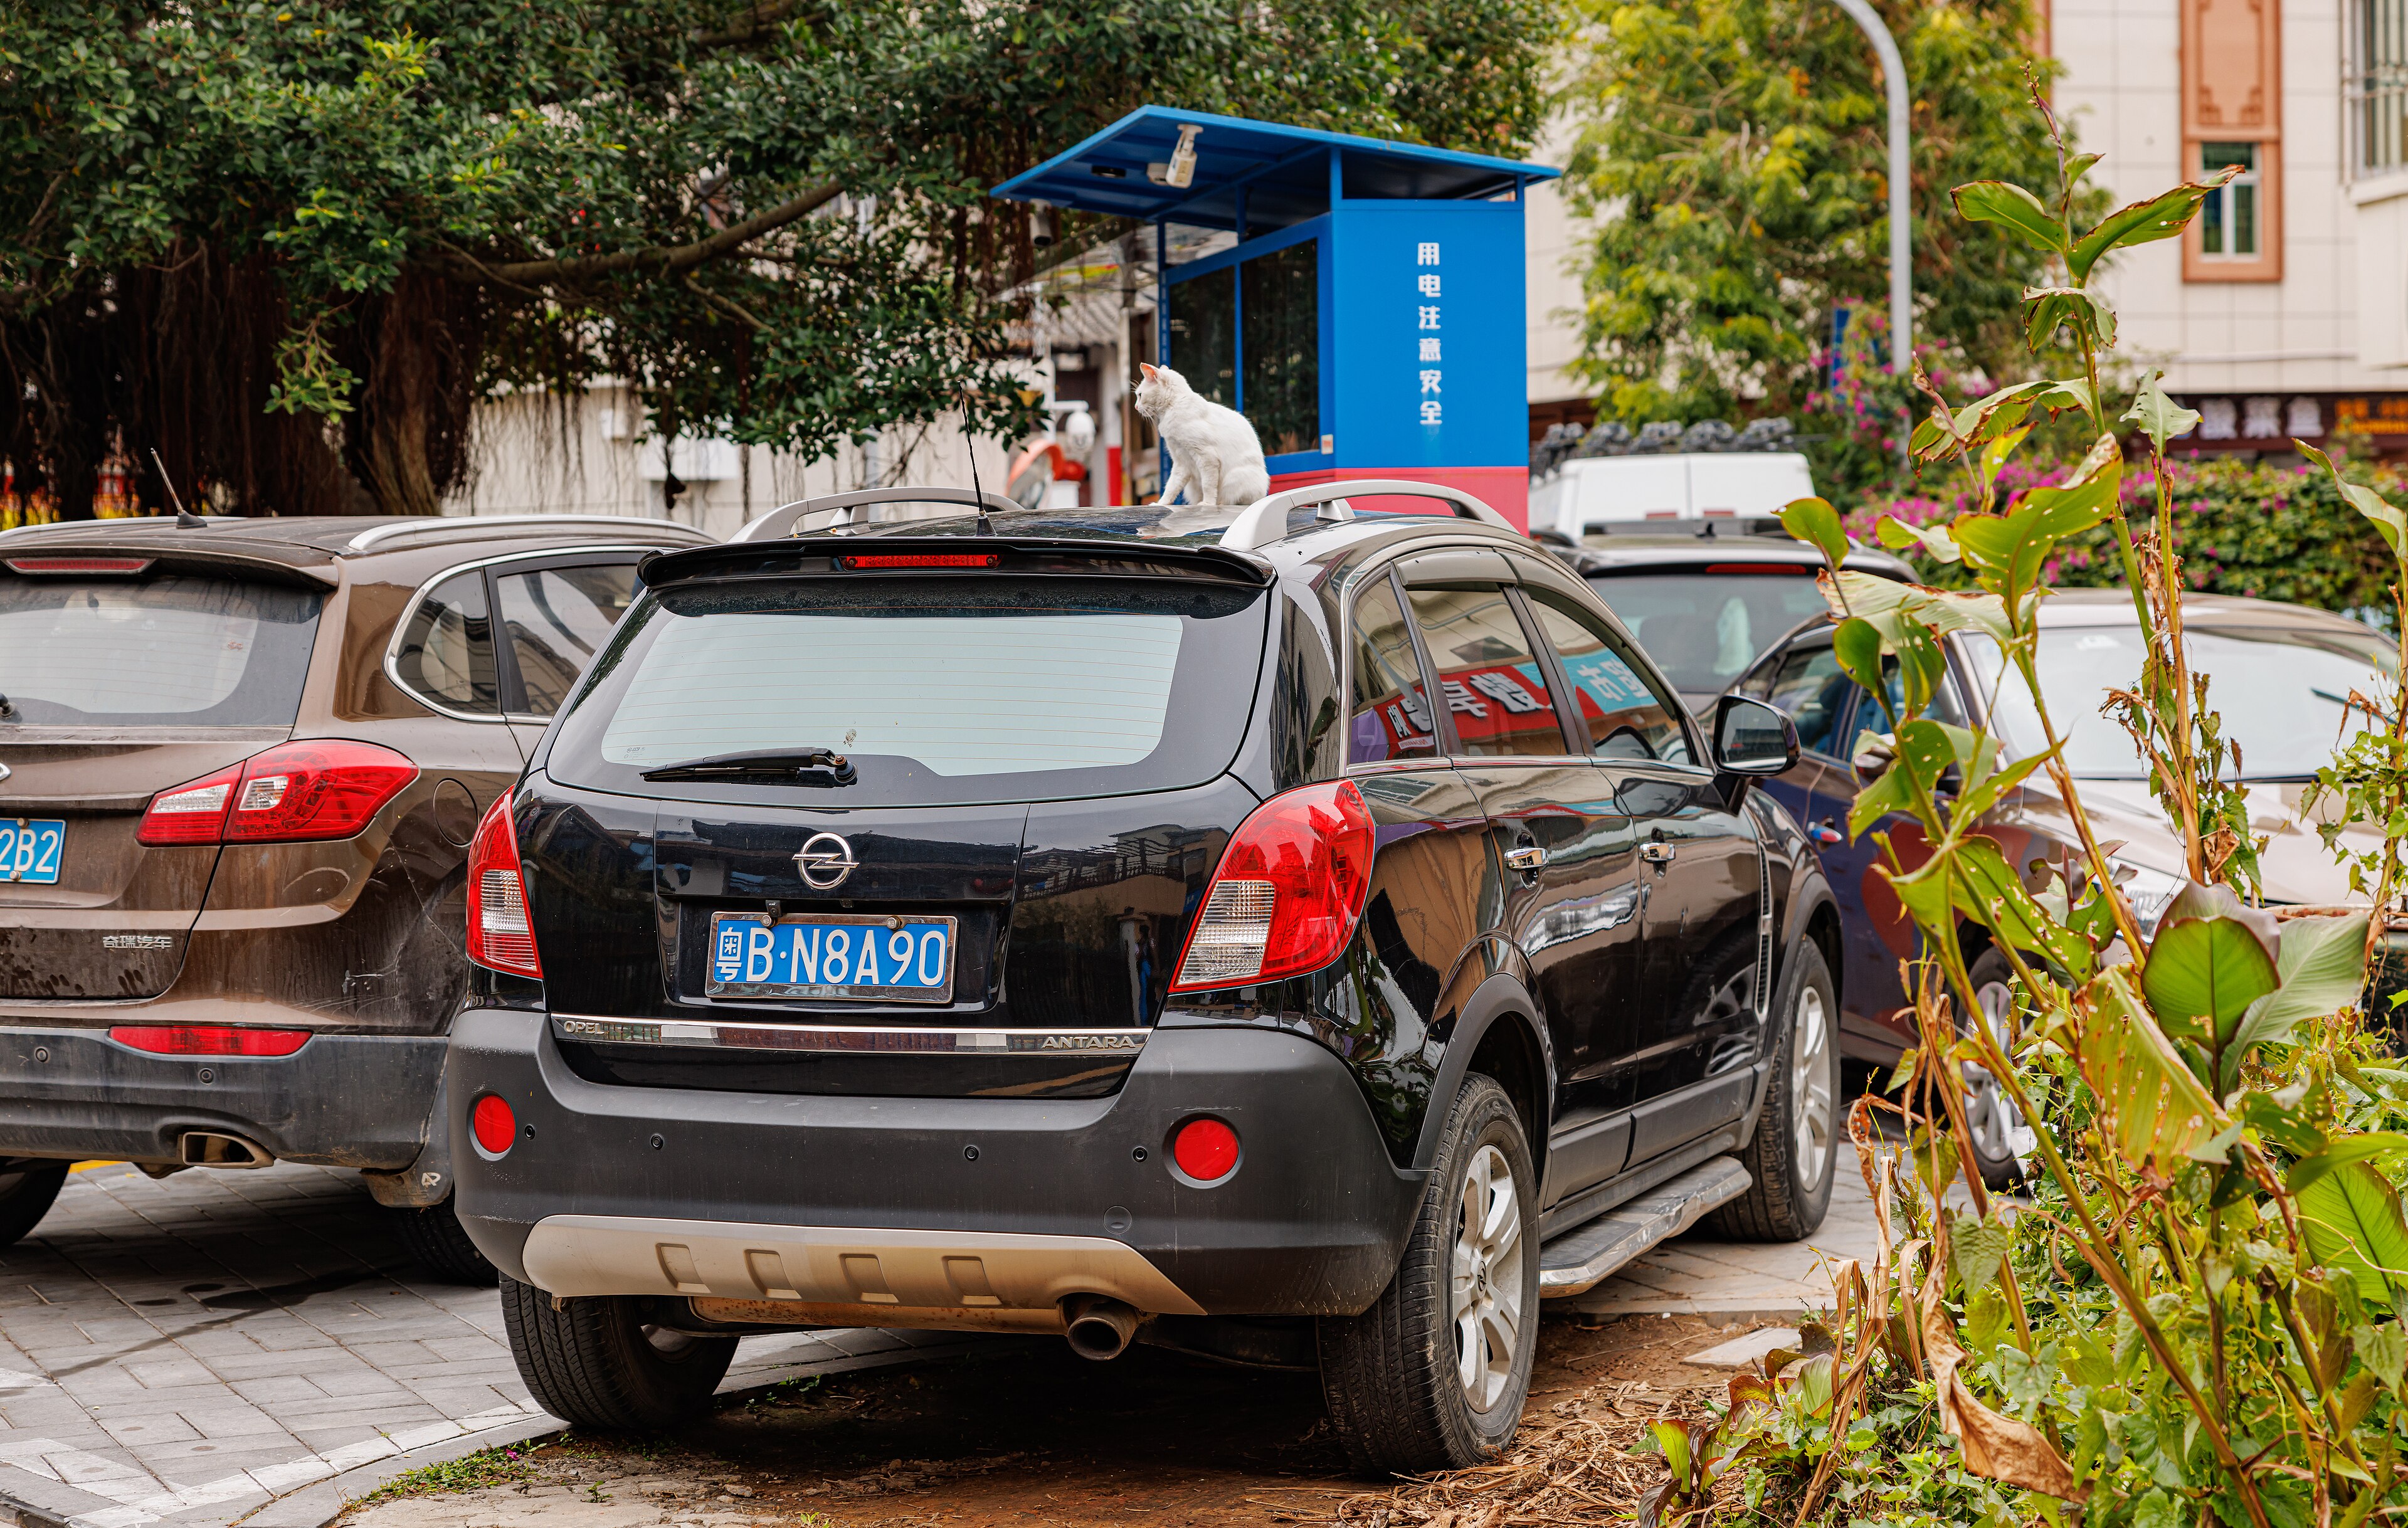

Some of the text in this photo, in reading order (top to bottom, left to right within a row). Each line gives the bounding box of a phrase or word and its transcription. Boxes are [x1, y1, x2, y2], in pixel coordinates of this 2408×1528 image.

[1417, 242, 1442, 425] 用电注意安全
[102, 935, 172, 949] 奇瑞汽车
[716, 927, 946, 986] 粤B·N8A90
[564, 1021, 605, 1035] OPEL
[1042, 1036, 1136, 1048] ANTARA
